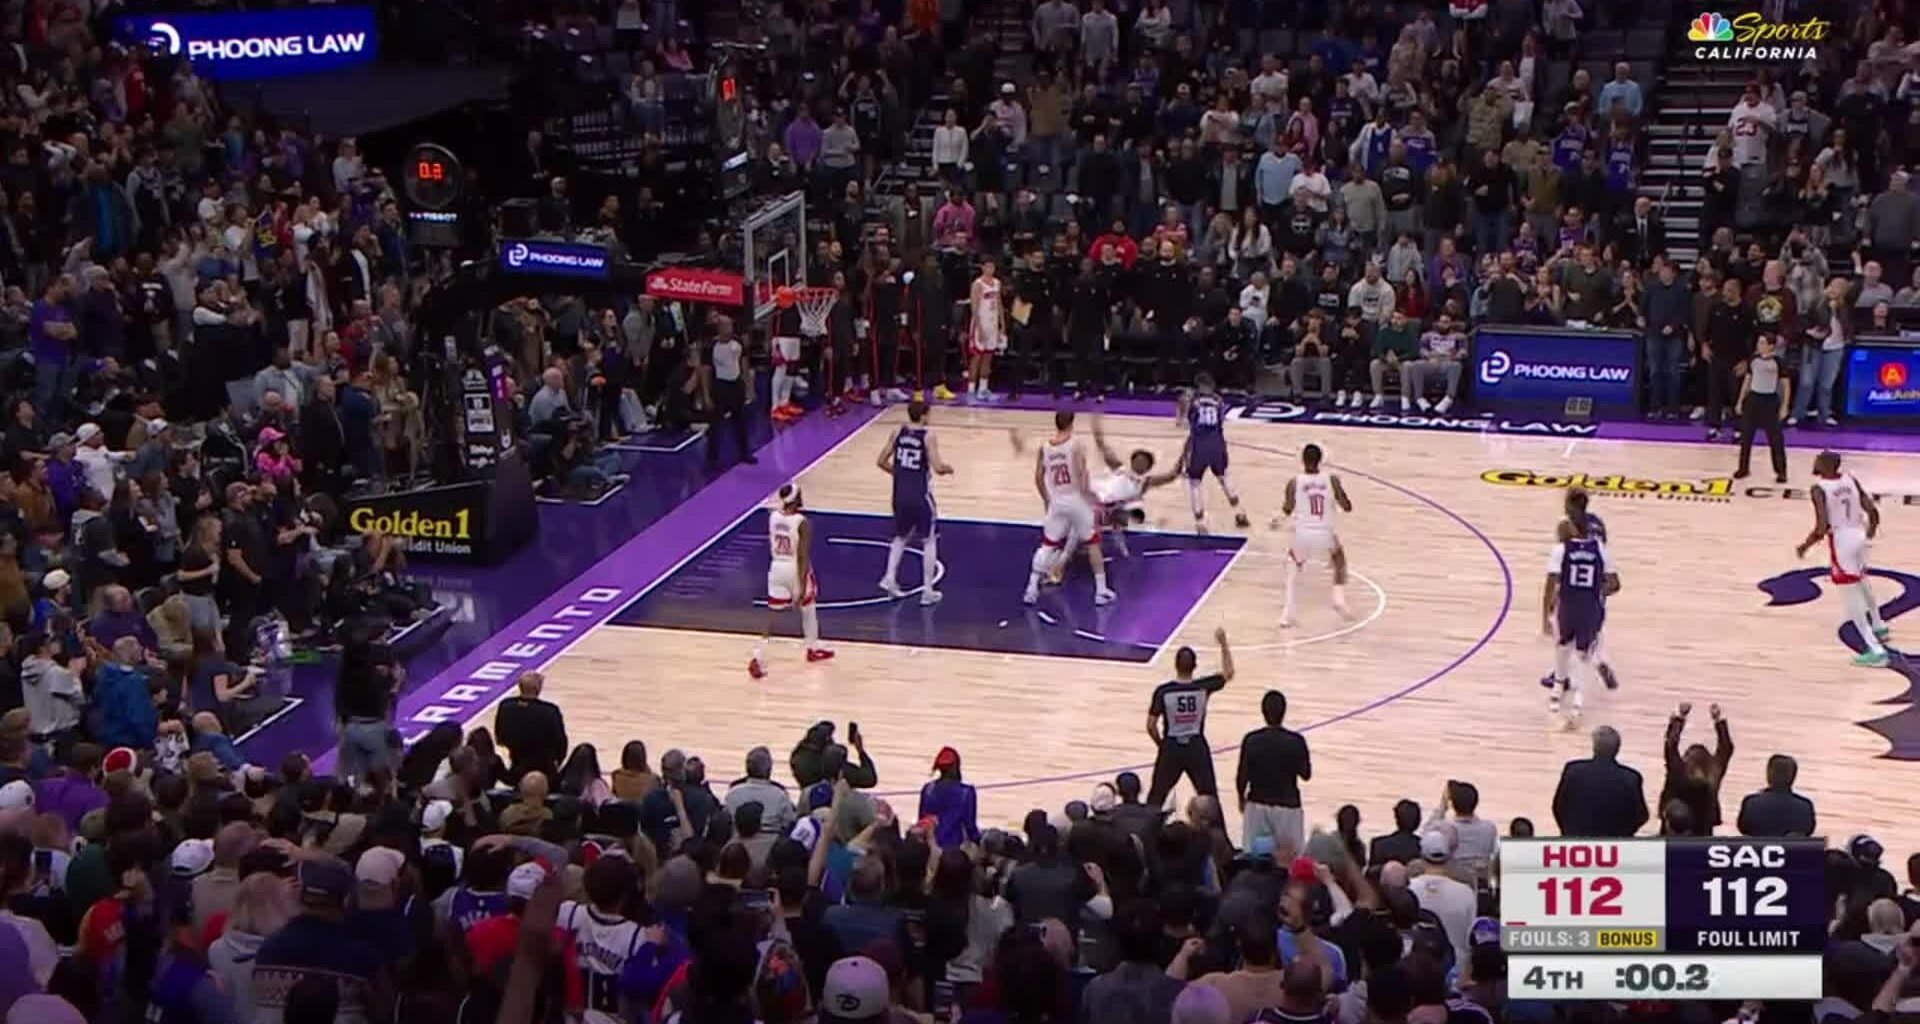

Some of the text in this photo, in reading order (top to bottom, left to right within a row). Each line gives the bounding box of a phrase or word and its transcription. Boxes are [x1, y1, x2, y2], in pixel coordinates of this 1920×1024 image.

[188, 32, 366, 61] PHOONG LAW
[529, 252, 605, 269] PHOONG LAW
[1513, 363, 1630, 381] PHOONG LAW
[1314, 412, 1598, 434] PHOONG LAW
[896, 447, 921, 469] 42
[1840, 498, 1852, 522] 7
[435, 540, 472, 554] Union
[1569, 564, 1595, 587] 13
[1177, 695, 1197, 713] 58
